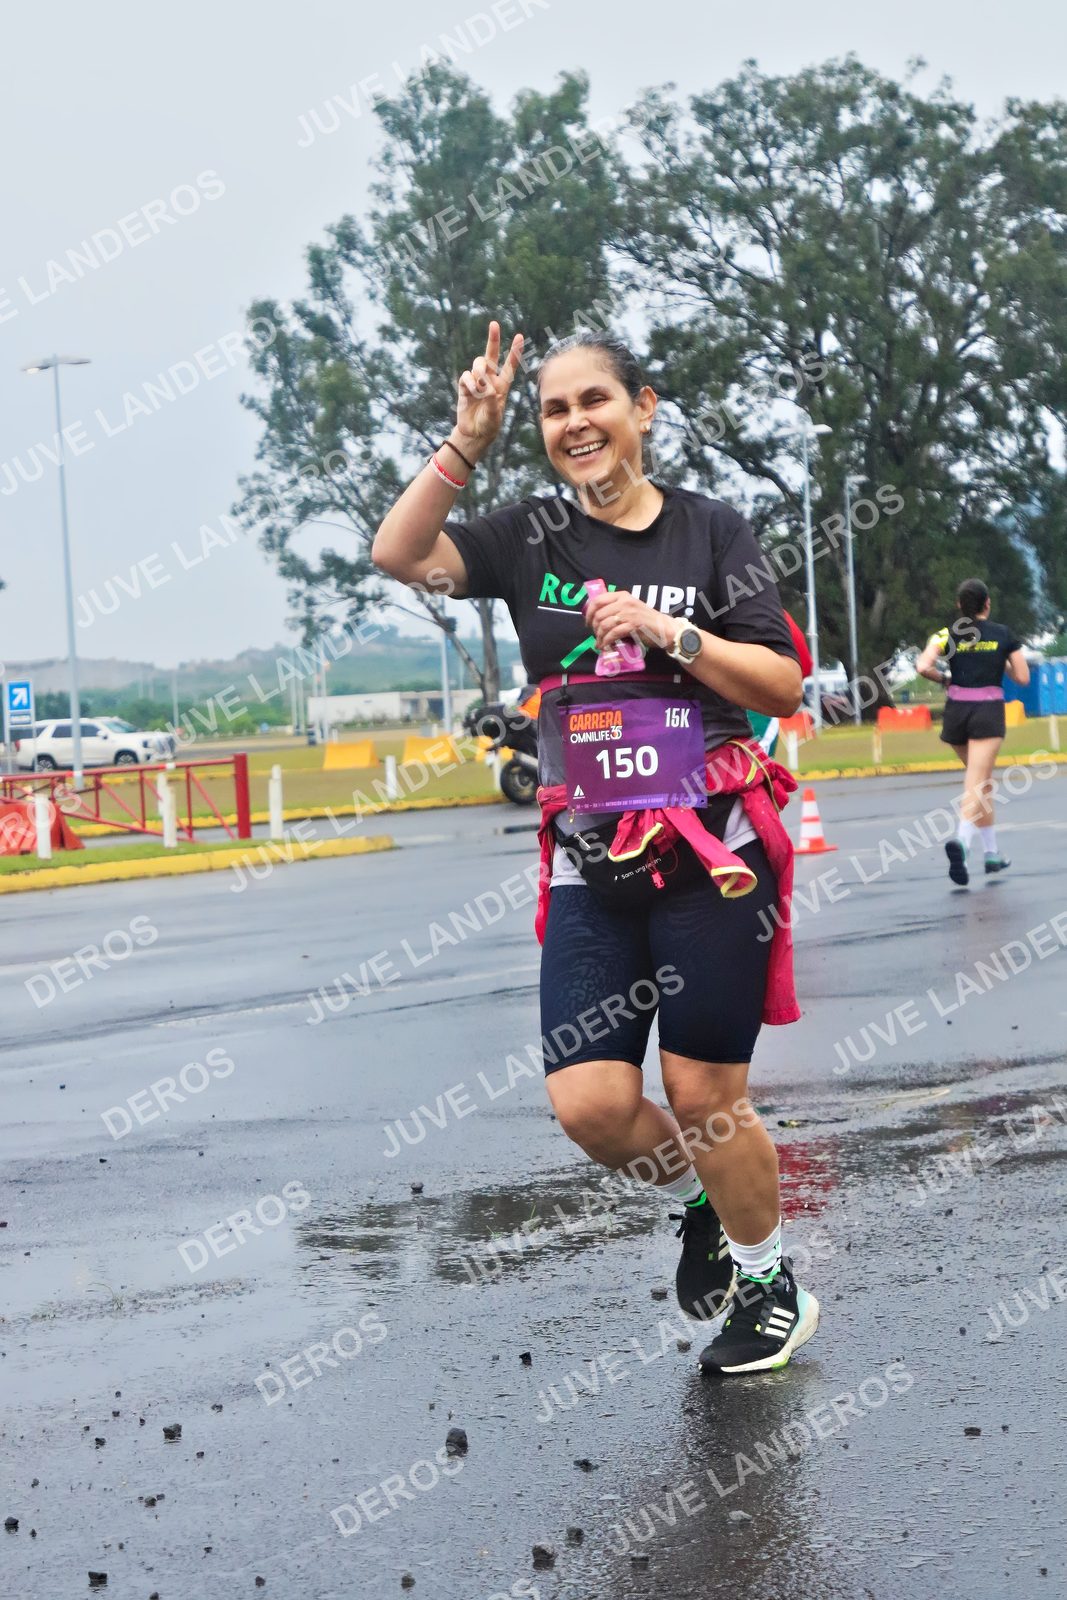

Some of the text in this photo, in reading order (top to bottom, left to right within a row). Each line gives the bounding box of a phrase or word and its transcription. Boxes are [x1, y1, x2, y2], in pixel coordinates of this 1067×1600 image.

[632, 585, 697, 616] UP!
[569, 710, 623, 732] CARRERA
[664, 707, 690, 728] 15K
[570, 730, 611, 744] OMNILIFE
[595, 746, 659, 779] 150
